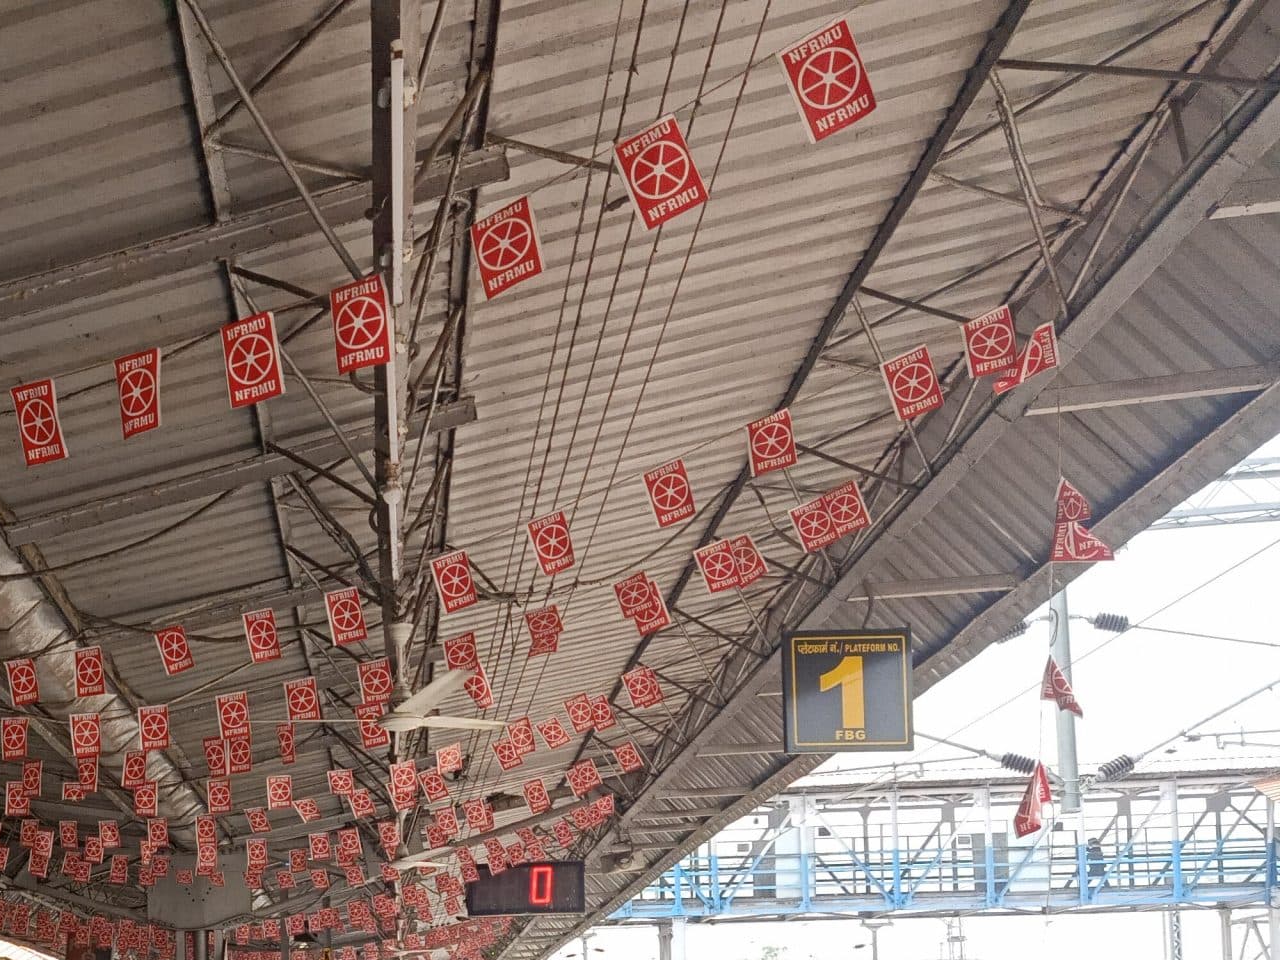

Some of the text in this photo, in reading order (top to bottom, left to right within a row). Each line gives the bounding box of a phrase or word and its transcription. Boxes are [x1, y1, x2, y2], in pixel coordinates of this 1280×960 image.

[788, 26, 842, 64] NFRMU
[816, 94, 869, 132] NFRMU
[623, 121, 670, 157] NFRMU
[648, 186, 699, 221] NFRMU
[477, 202, 522, 231] NFRMU
[488, 260, 535, 291] NFRMU
[336, 281, 378, 303] NFRMU
[969, 310, 1004, 330] NFRMU
[227, 318, 266, 341] NFRMU
[119, 353, 153, 373] NFRMU
[341, 347, 384, 367] NFRMU
[888, 350, 923, 372] NFRMU
[976, 356, 1013, 373] NFRMU
[16, 385, 48, 402] NFRMU
[235, 380, 276, 401] NFRMU
[902, 395, 938, 416] NFRMU
[124, 413, 155, 432] NFRMU
[752, 411, 785, 429] NFRMU
[28, 444, 60, 460] NFRMU
[649, 461, 679, 482] NFRMU
[757, 455, 792, 471] NFRMU
[825, 485, 852, 501] NFRMU
[661, 506, 692, 523] NFRMU
[795, 502, 821, 517] NFRMU
[532, 513, 560, 531] NFRMU
[837, 518, 865, 534] NFRMU
[807, 532, 835, 548] NFRMU
[700, 543, 727, 557] NFRMU
[436, 553, 464, 569] NFRMU
[545, 555, 573, 571] NFRMU
[712, 576, 738, 589] NFRMU
[330, 590, 355, 602] NFRMU
[448, 593, 475, 608] NFRMU
[338, 629, 364, 641] NFRMU
[844, 643, 886, 653] PLATEFORM
[887, 643, 900, 652] NO.
[820, 656, 865, 729] 1
[835, 730, 866, 740] FBG
